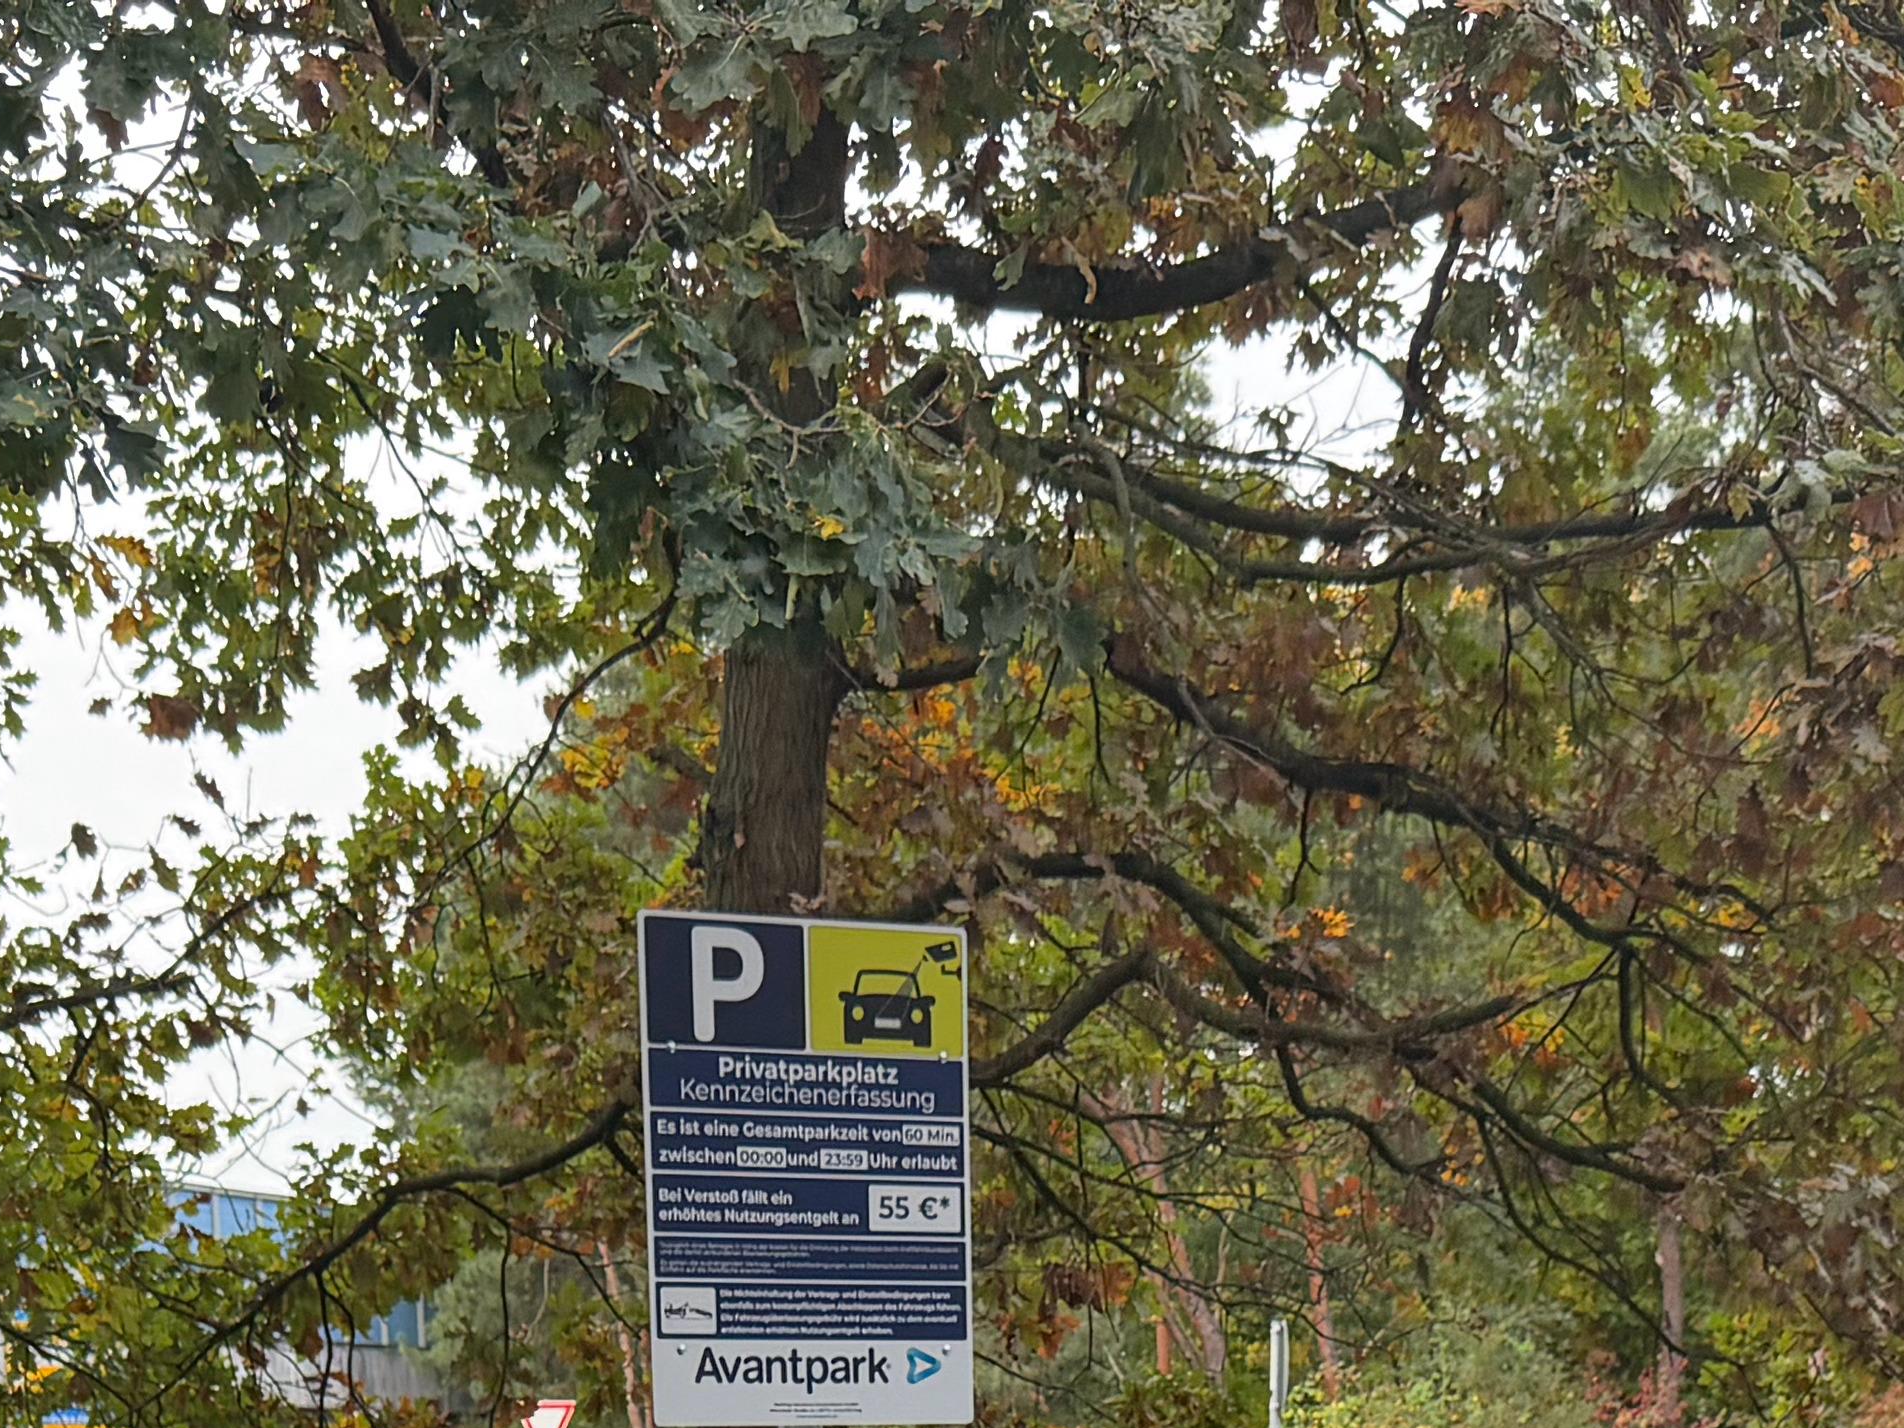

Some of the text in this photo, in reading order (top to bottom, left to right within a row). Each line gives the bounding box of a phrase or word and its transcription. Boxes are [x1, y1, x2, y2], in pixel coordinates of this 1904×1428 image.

[691, 926, 764, 1042] P
[718, 1056, 899, 1086] Privatparkplatz
[680, 1078, 936, 1114] Kennzeichenerfassung
[657, 1116, 959, 1144] Es ist eine Gesamtparkzeit von 60 Min.
[659, 1144, 958, 1172] zwischen 00:00 und 23:59 Uhr erlaubt
[658, 1187, 793, 1206] Bei Verstoß fällt ein
[878, 1195, 911, 1220] 55
[658, 1206, 860, 1228] erhöhtes Nutzungsentgelt an
[694, 1347, 890, 1394] Avantpark
